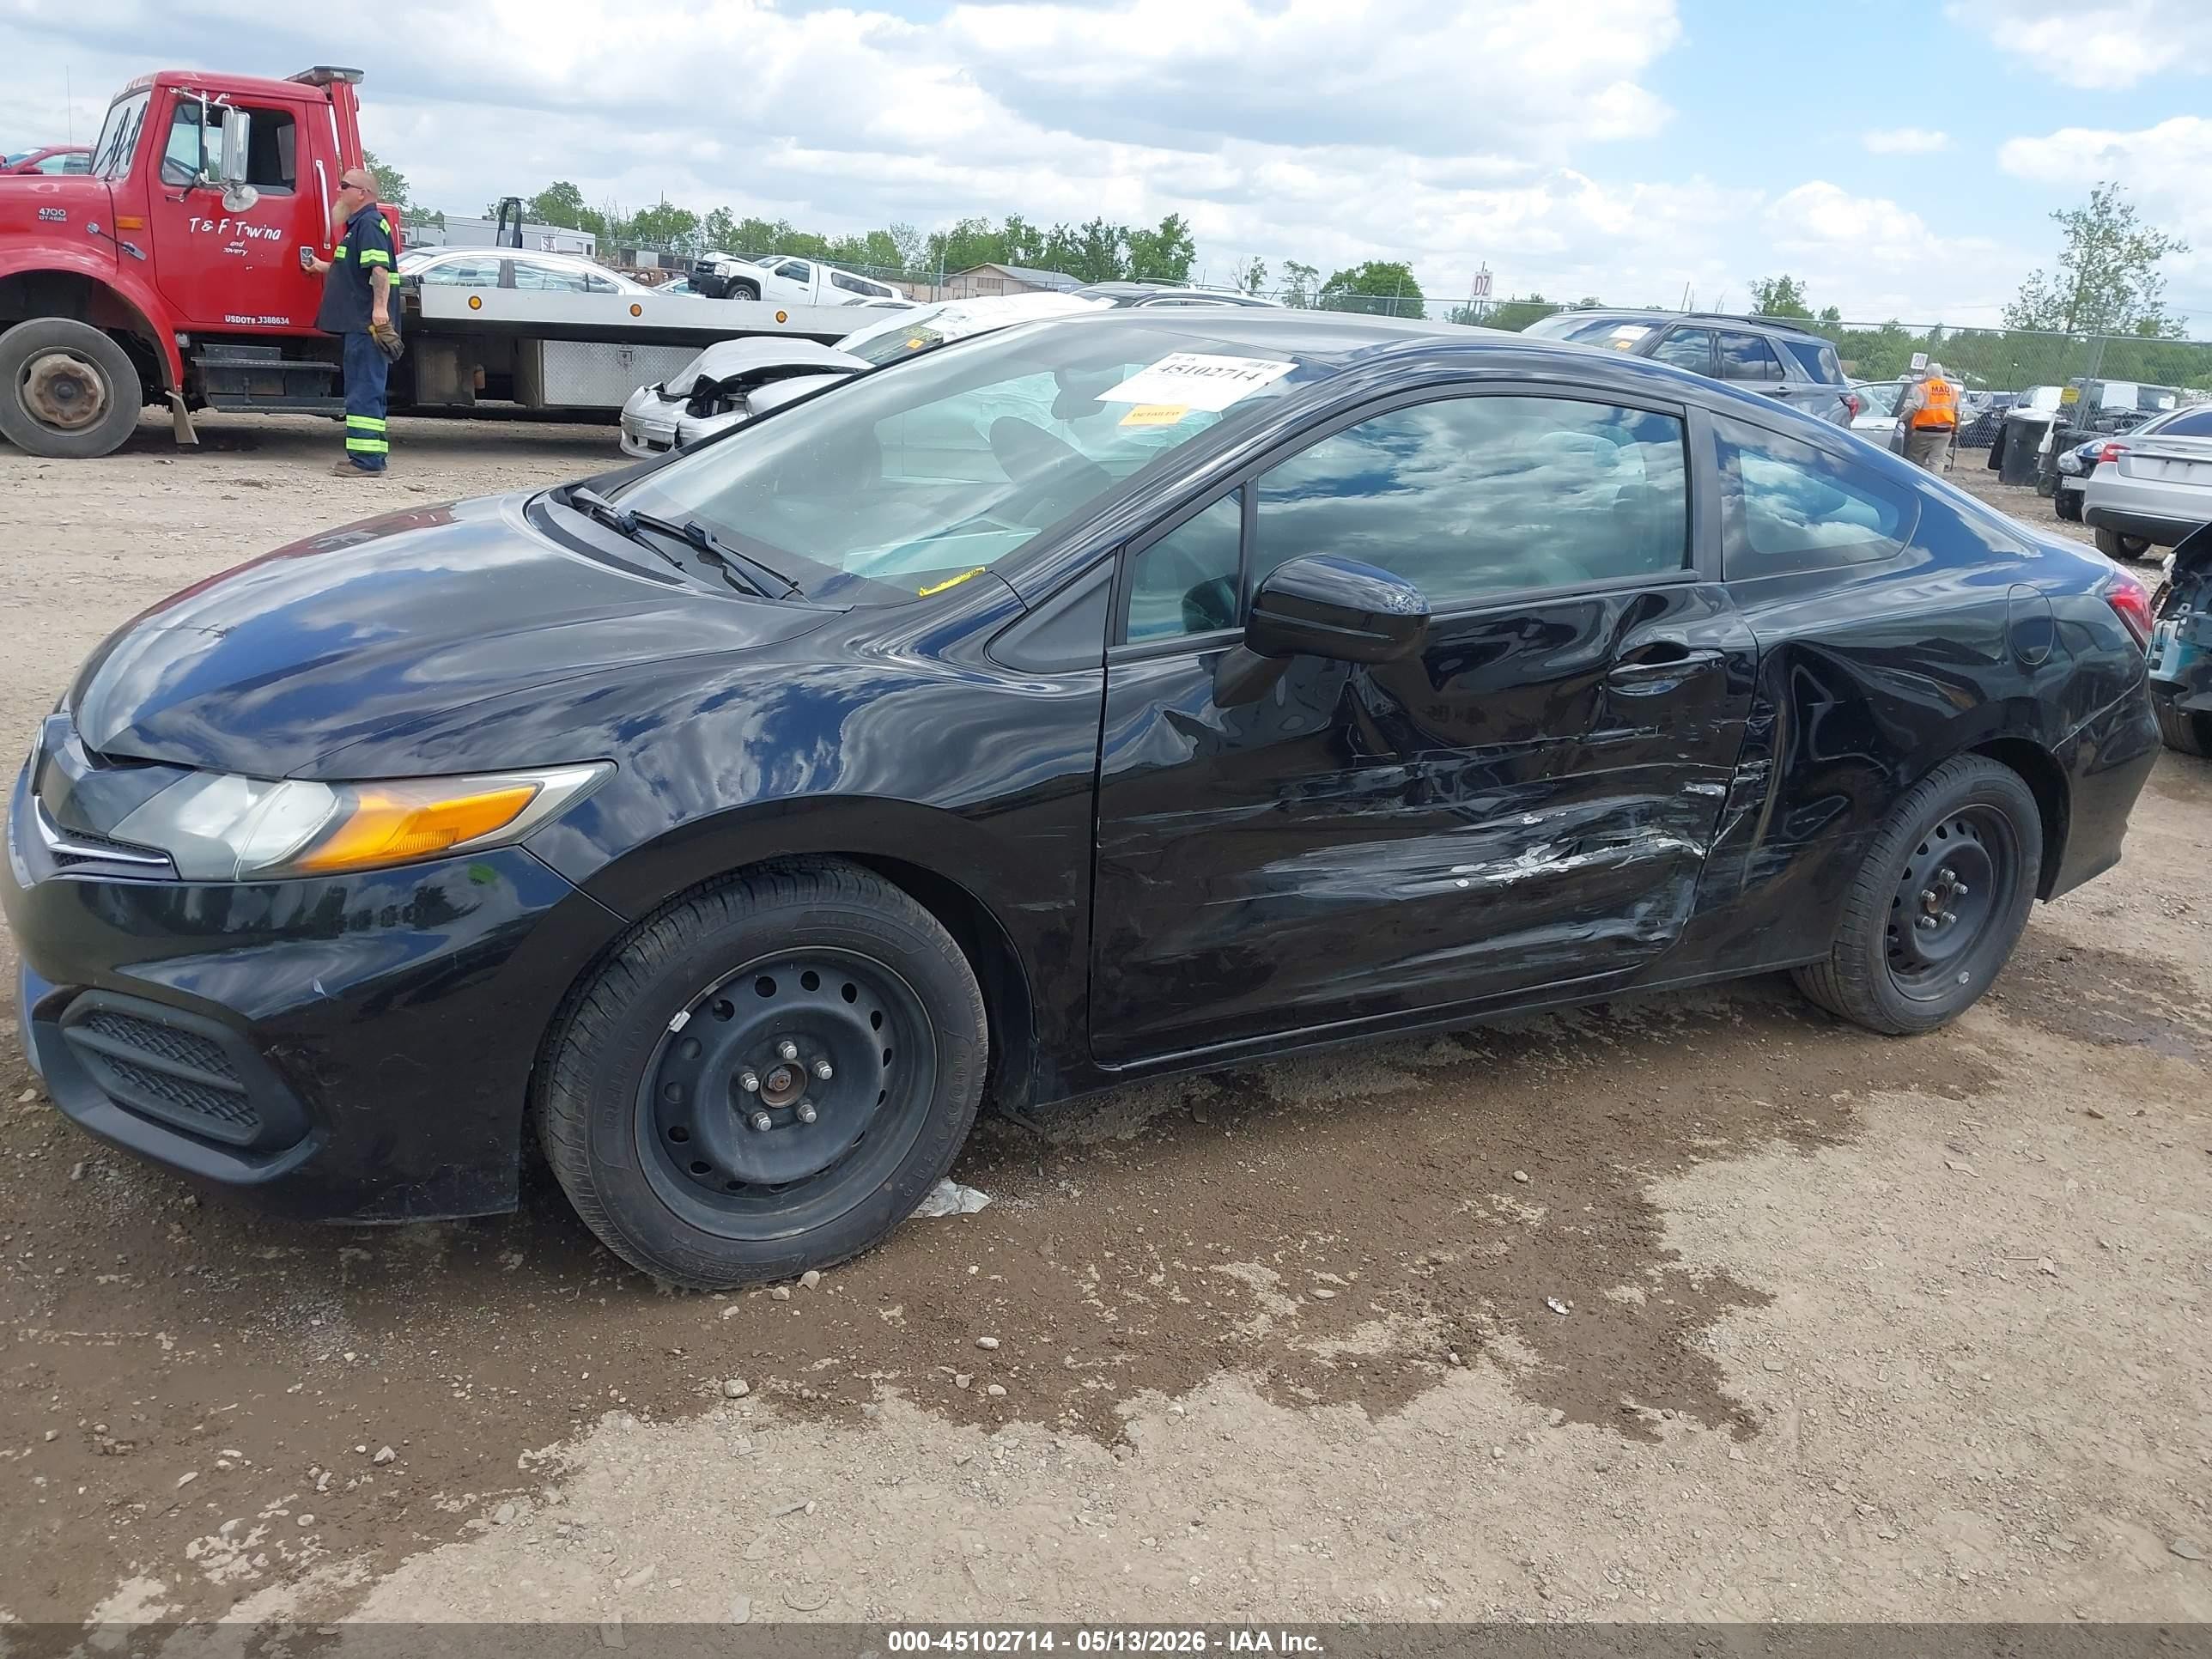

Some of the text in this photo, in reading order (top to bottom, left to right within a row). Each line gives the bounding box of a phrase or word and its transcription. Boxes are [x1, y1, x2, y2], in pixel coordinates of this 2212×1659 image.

[39, 208, 66, 216] 4700
[189, 217, 201, 234] T
[201, 220, 214, 232] &
[217, 218, 231, 234] F
[1474, 275, 1490, 296] DZ
[1158, 363, 1263, 381] 45102714
